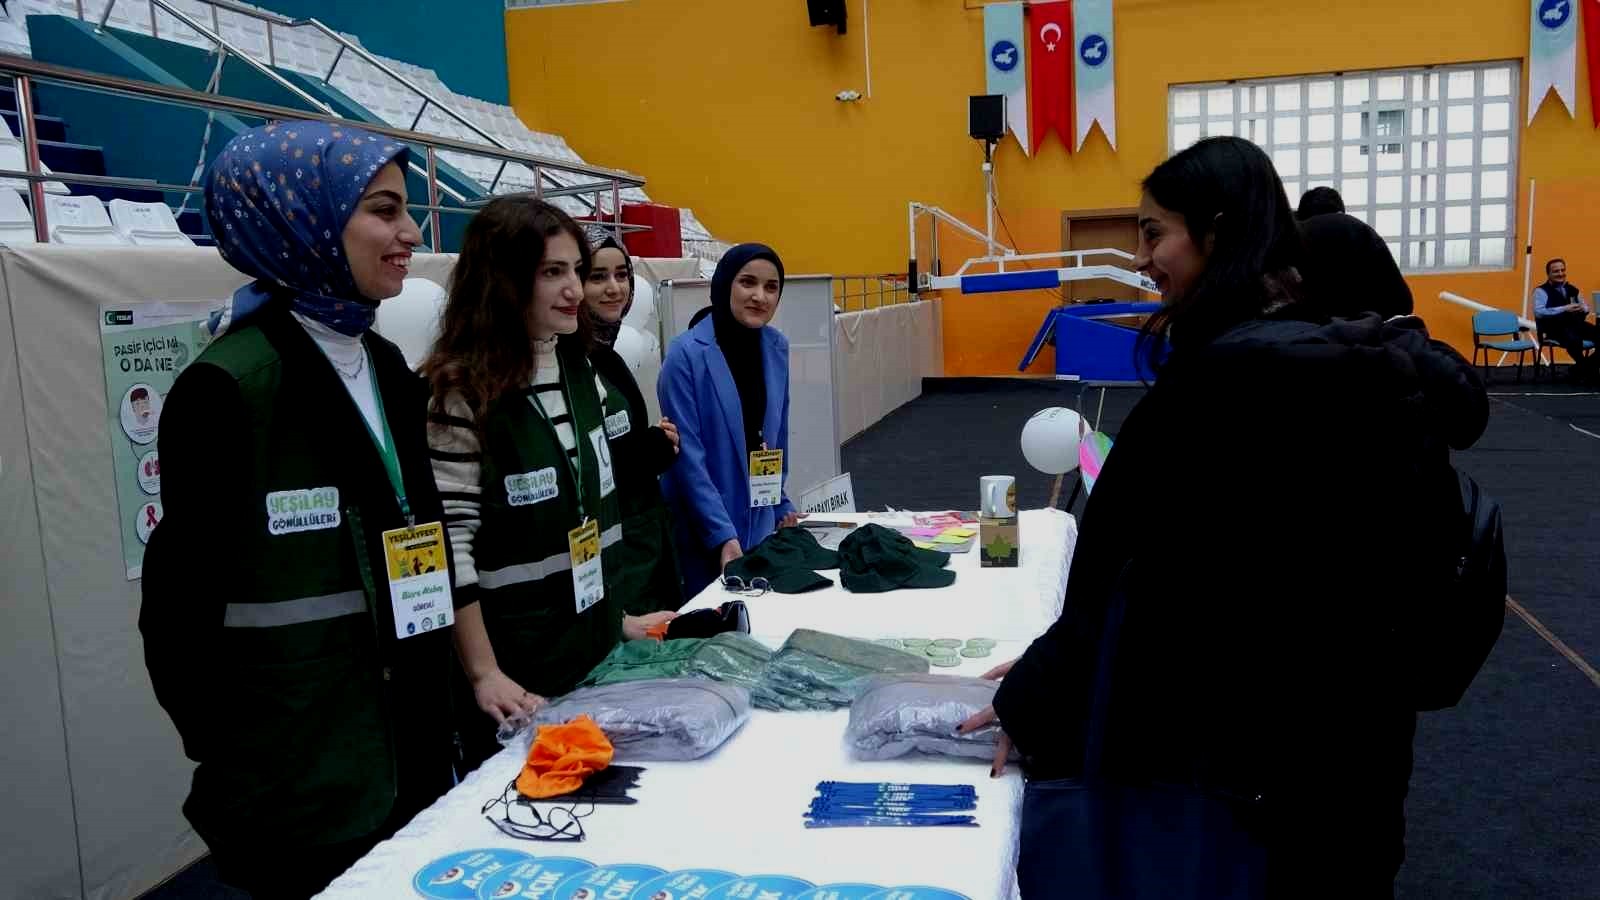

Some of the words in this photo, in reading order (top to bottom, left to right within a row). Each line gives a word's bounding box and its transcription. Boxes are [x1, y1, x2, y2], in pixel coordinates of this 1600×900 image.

[120, 358, 131, 372] O
[134, 358, 153, 372] DA
[270, 491, 336, 513] YEŞİLAY
[272, 512, 337, 530] GÖNÜLLÜLERİ
